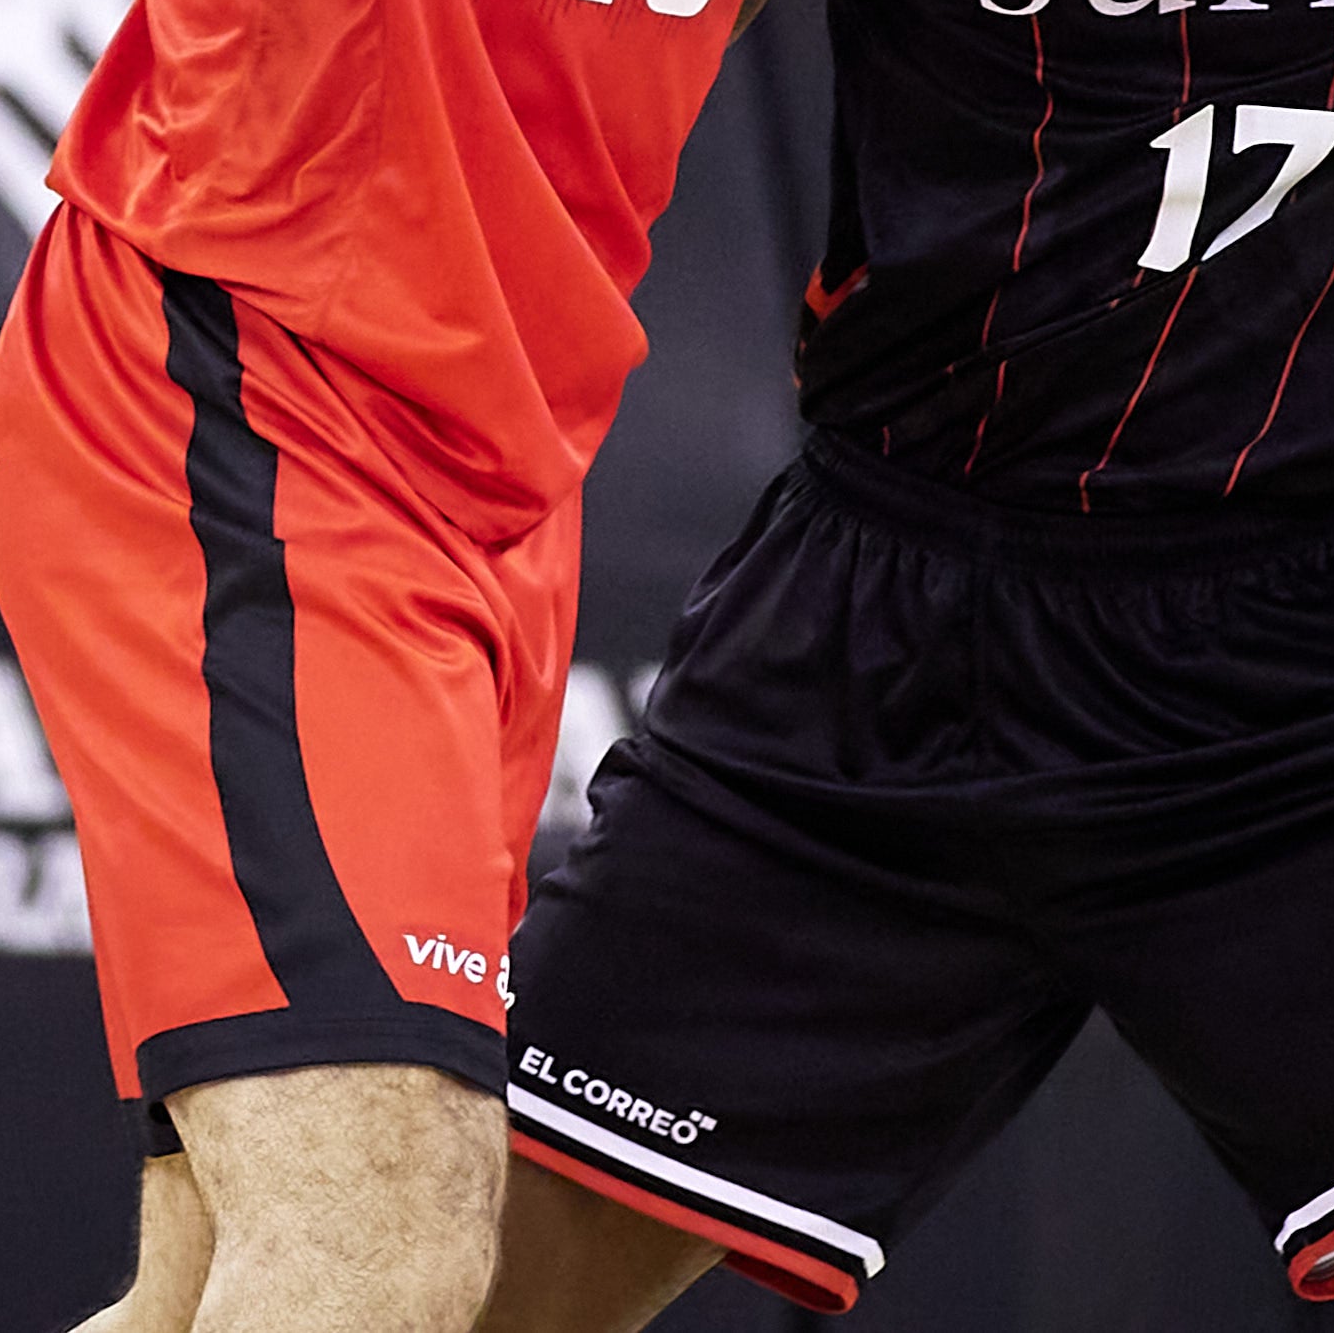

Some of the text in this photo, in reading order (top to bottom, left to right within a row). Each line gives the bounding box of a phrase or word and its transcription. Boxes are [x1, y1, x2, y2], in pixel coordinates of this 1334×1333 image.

[403, 934, 487, 983] vive
[519, 1046, 698, 1144] EL CORREO
